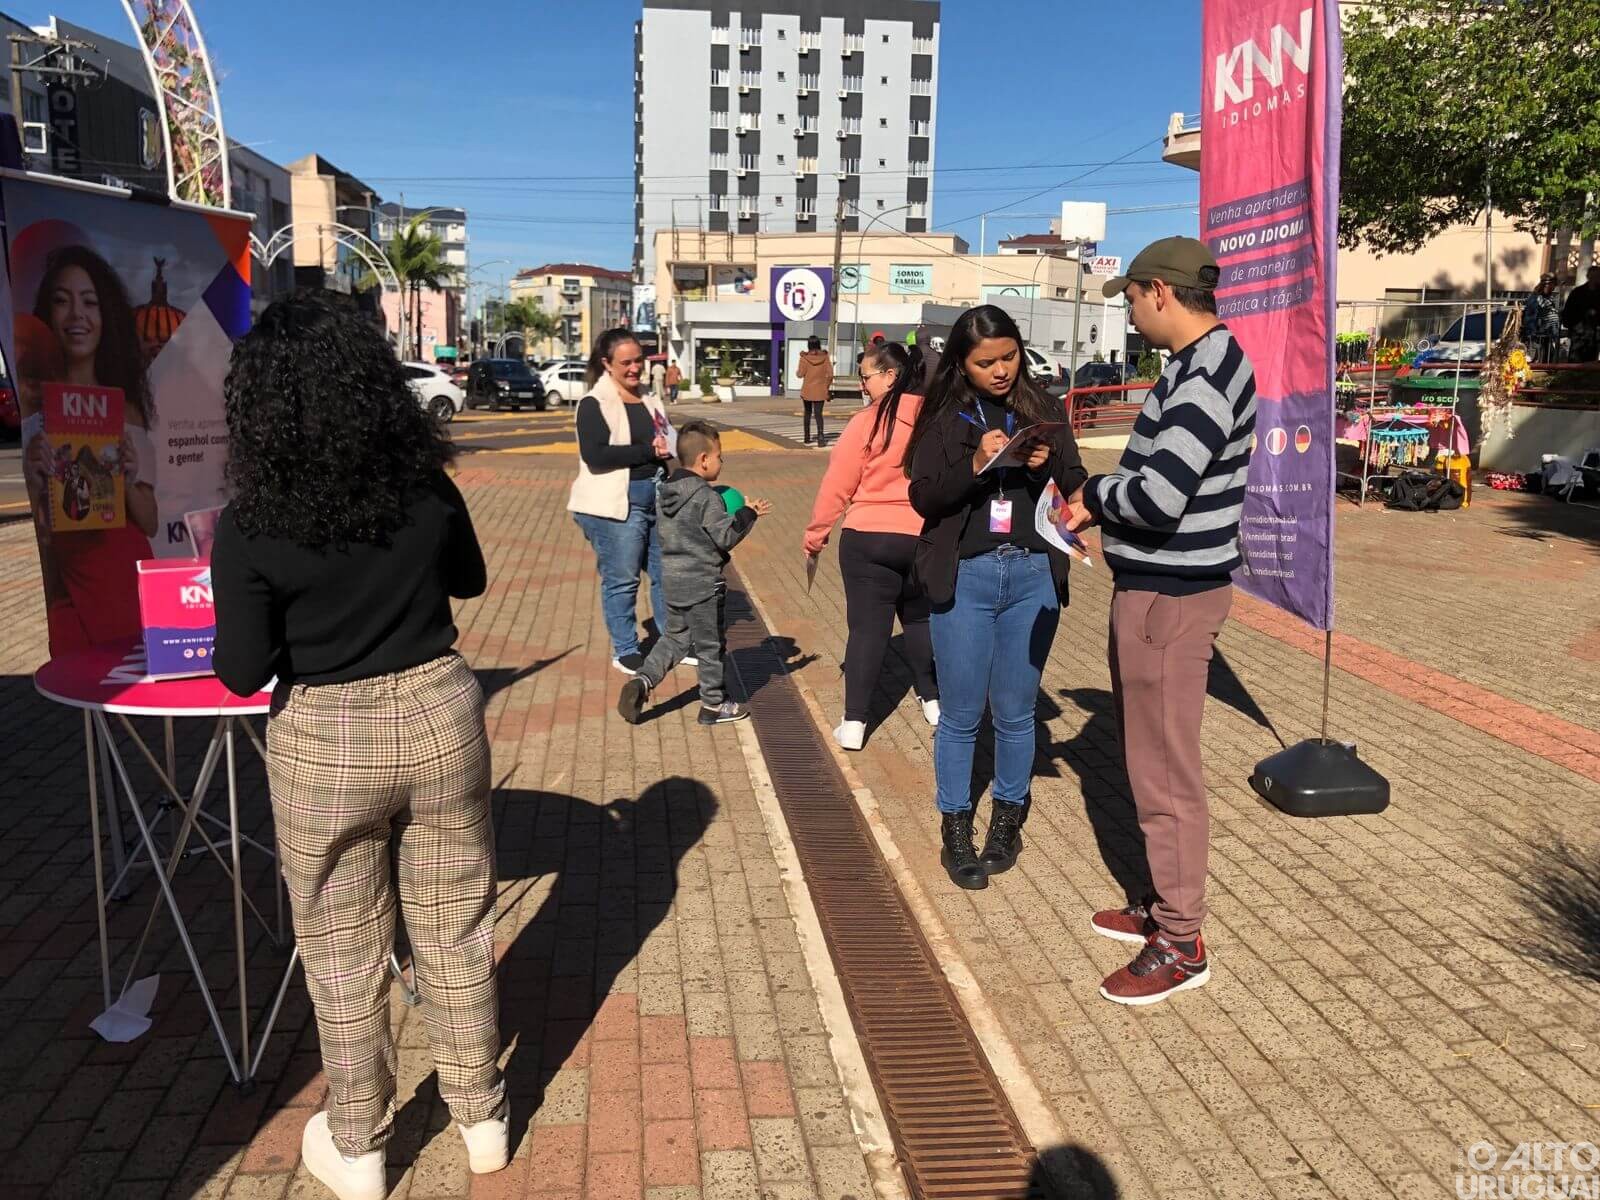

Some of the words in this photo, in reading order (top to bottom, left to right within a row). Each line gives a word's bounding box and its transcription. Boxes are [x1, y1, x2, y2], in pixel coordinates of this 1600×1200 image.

[1214, 8, 1312, 112] KNN
[1222, 83, 1305, 129] IDIOMAS
[1209, 206, 1241, 225] Venha
[1245, 190, 1298, 216] aprender
[1219, 233, 1256, 253] NOVO
[1230, 267, 1244, 282] de
[1248, 257, 1296, 278] maneira
[1218, 298, 1259, 318] prática
[62, 392, 107, 418] KNN
[168, 433, 209, 449] espanhol
[168, 455, 175, 464] a
